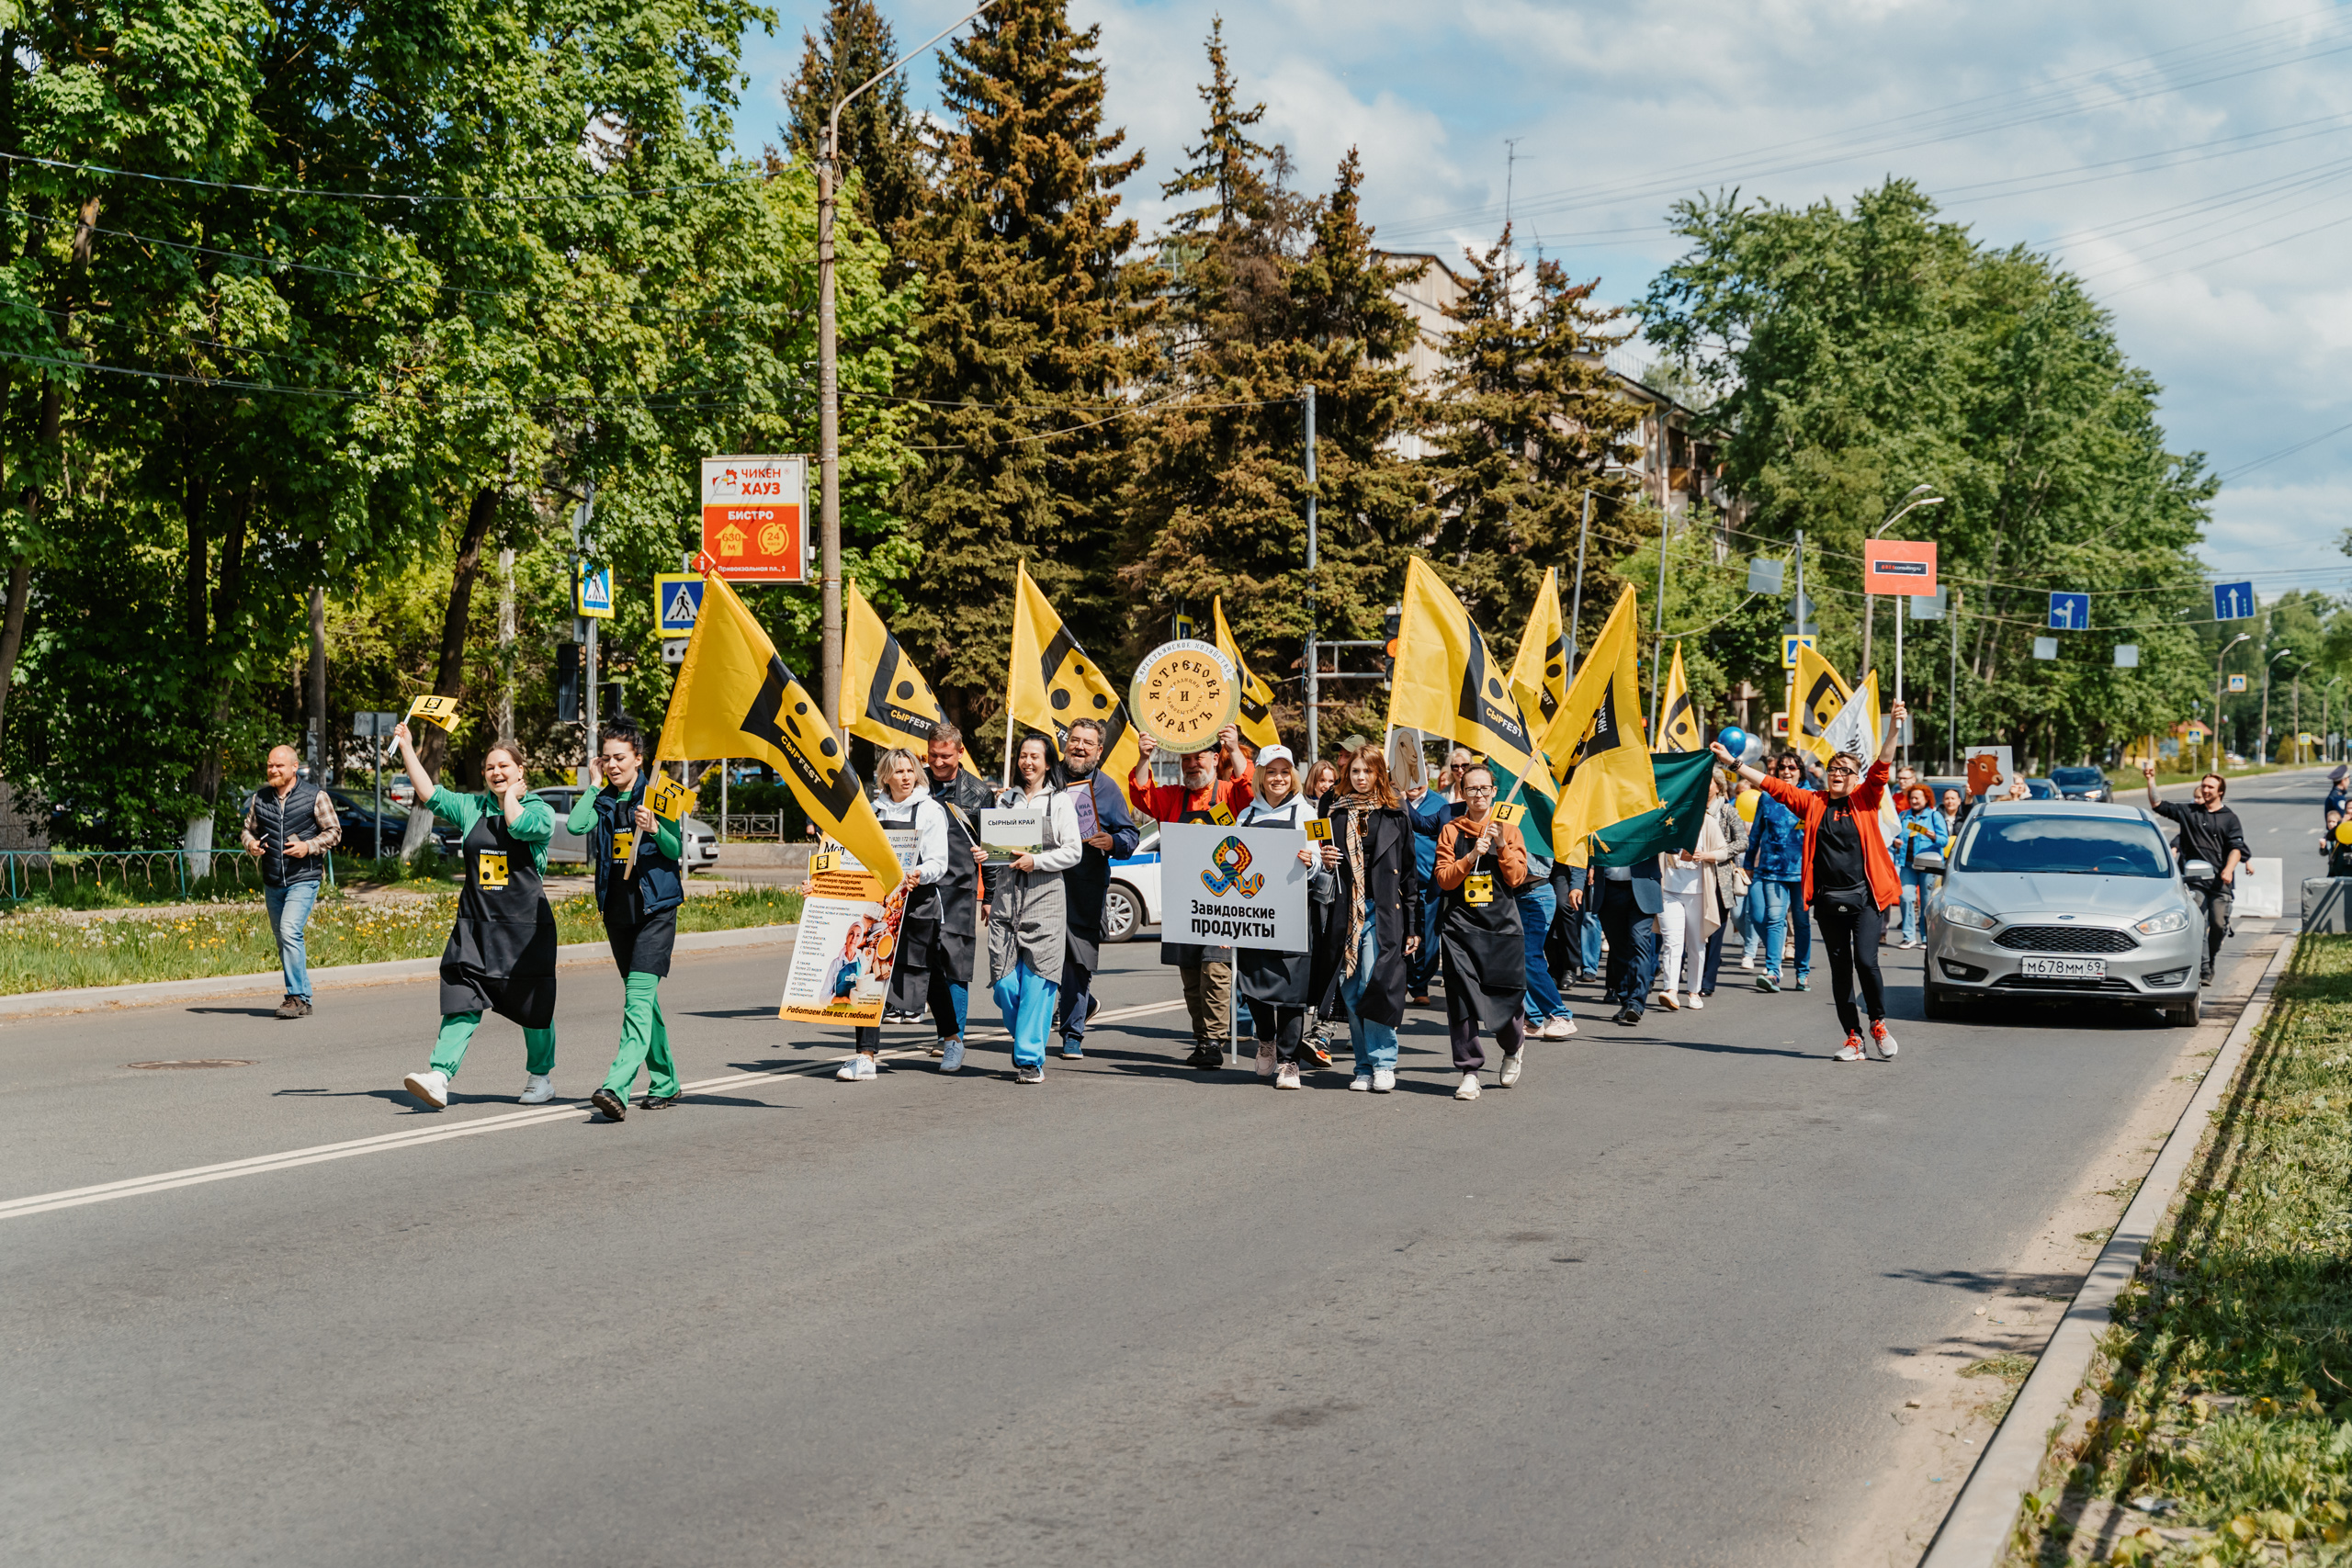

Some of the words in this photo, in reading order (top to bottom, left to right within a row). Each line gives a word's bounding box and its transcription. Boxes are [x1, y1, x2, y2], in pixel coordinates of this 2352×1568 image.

[741, 468, 781, 478] ЧИКЕН
[741, 482, 781, 495] ХАУЗ
[728, 511, 774, 520] БИСТРО
[722, 533, 741, 542] 630
[767, 532, 781, 541] 24
[1139, 642, 1191, 675] КРЕСТЬЯНСКОЕ
[1194, 643, 1232, 673] ХОЗЯЙСТВО
[1180, 691, 1189, 702] И
[891, 709, 932, 730] СЫРFEST
[1487, 707, 1521, 737] СЫРFEST
[781, 735, 821, 784] СЫРFEST
[824, 841, 845, 855] Мол
[1191, 899, 1275, 919] Завидовские
[1191, 919, 1275, 940] продукты
[2028, 961, 2084, 974] М678ММ
[2087, 962, 2100, 972] 69
[786, 1006, 820, 1016] Работаем
[821, 1009, 832, 1017] для
[848, 1011, 876, 1020] любовью!
